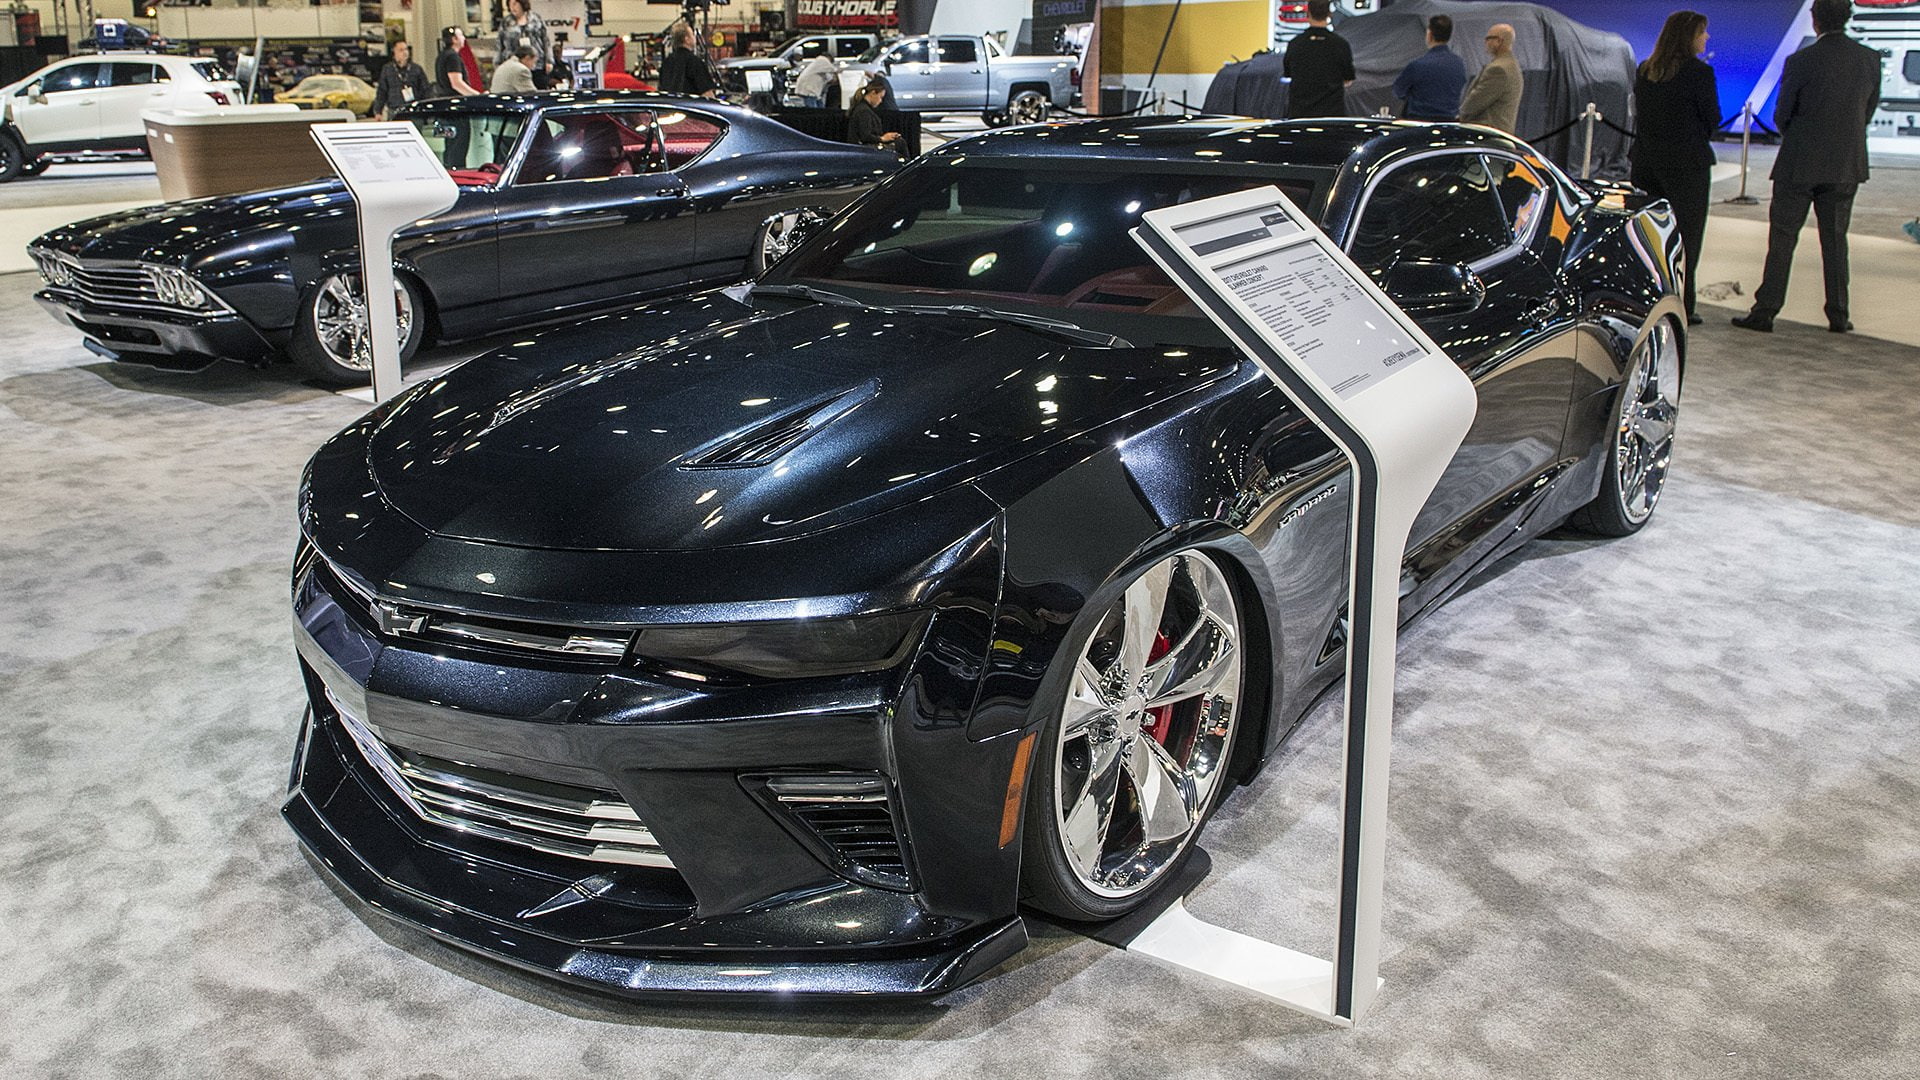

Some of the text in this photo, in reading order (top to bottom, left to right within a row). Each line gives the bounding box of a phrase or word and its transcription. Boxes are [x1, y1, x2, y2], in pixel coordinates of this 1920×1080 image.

[822, 1, 896, 15] THORLE
[1043, 0, 1086, 16] CHEVROLET
[1230, 269, 1253, 280] CHEVROLET
[1252, 264, 1269, 274] CAMARO
[1246, 273, 1265, 285] CONCEPT
[1278, 485, 1338, 529] CAMARO
